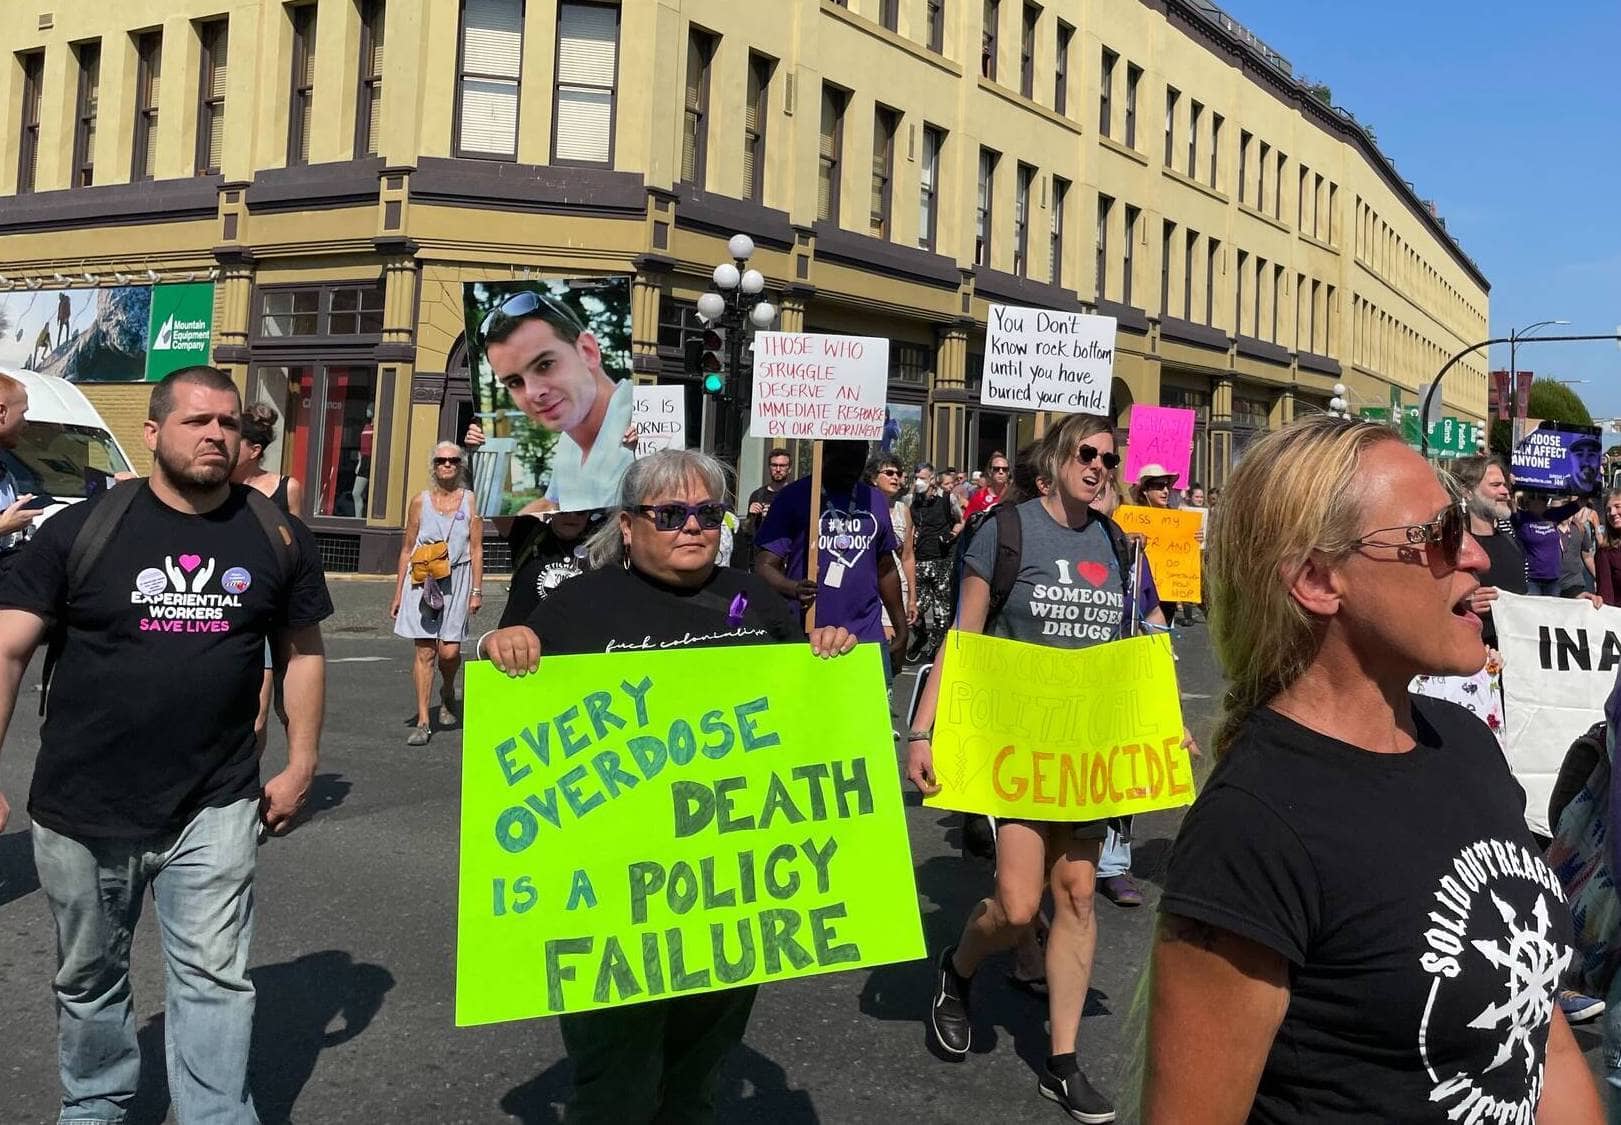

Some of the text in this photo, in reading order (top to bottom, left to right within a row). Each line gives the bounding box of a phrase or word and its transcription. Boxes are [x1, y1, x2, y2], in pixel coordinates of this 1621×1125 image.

[173, 319, 206, 330] Mountain
[994, 306, 1080, 334] You Don't
[173, 330, 210, 341] Equipment
[172, 340, 206, 352] Company
[763, 336, 864, 360] THOSE WHO
[1036, 340, 1070, 357] rock
[1073, 340, 1112, 365] bottom
[759, 361, 836, 381] STRUGGLE
[990, 360, 1094, 385] until you have
[758, 382, 861, 401] DESERVE AN
[988, 379, 1106, 410] buried your child.
[662, 398, 675, 414] IS
[758, 402, 884, 421] IMMEDIATE RESPONSE
[768, 419, 883, 438] BY OUR GOVERNMENT
[1444, 419, 1453, 444] Climb
[1511, 454, 1550, 469] ANYONE
[1533, 446, 1567, 459] AFFECT
[1166, 540, 1191, 554] AND
[1055, 559, 1073, 584] I
[131, 591, 242, 607] EXPERIENTIAL
[1032, 584, 1124, 608] SOMEONE
[149, 605, 223, 620] WORKERS
[1029, 601, 1080, 620] WHO
[139, 619, 230, 633] SAVE LIVES
[1042, 621, 1112, 641] DRUGS
[605, 635, 656, 654] fuck
[948, 680, 1160, 748] POLITICAL
[494, 676, 655, 786] EVERY
[495, 696, 781, 853] OVERDOSE
[992, 736, 1192, 807] GENOCIDE
[670, 757, 875, 838] DEATH
[492, 836, 838, 924] IS A POLICY
[1418, 838, 1569, 978] SOLID OUTREACH
[544, 902, 861, 1012] FAILURE
